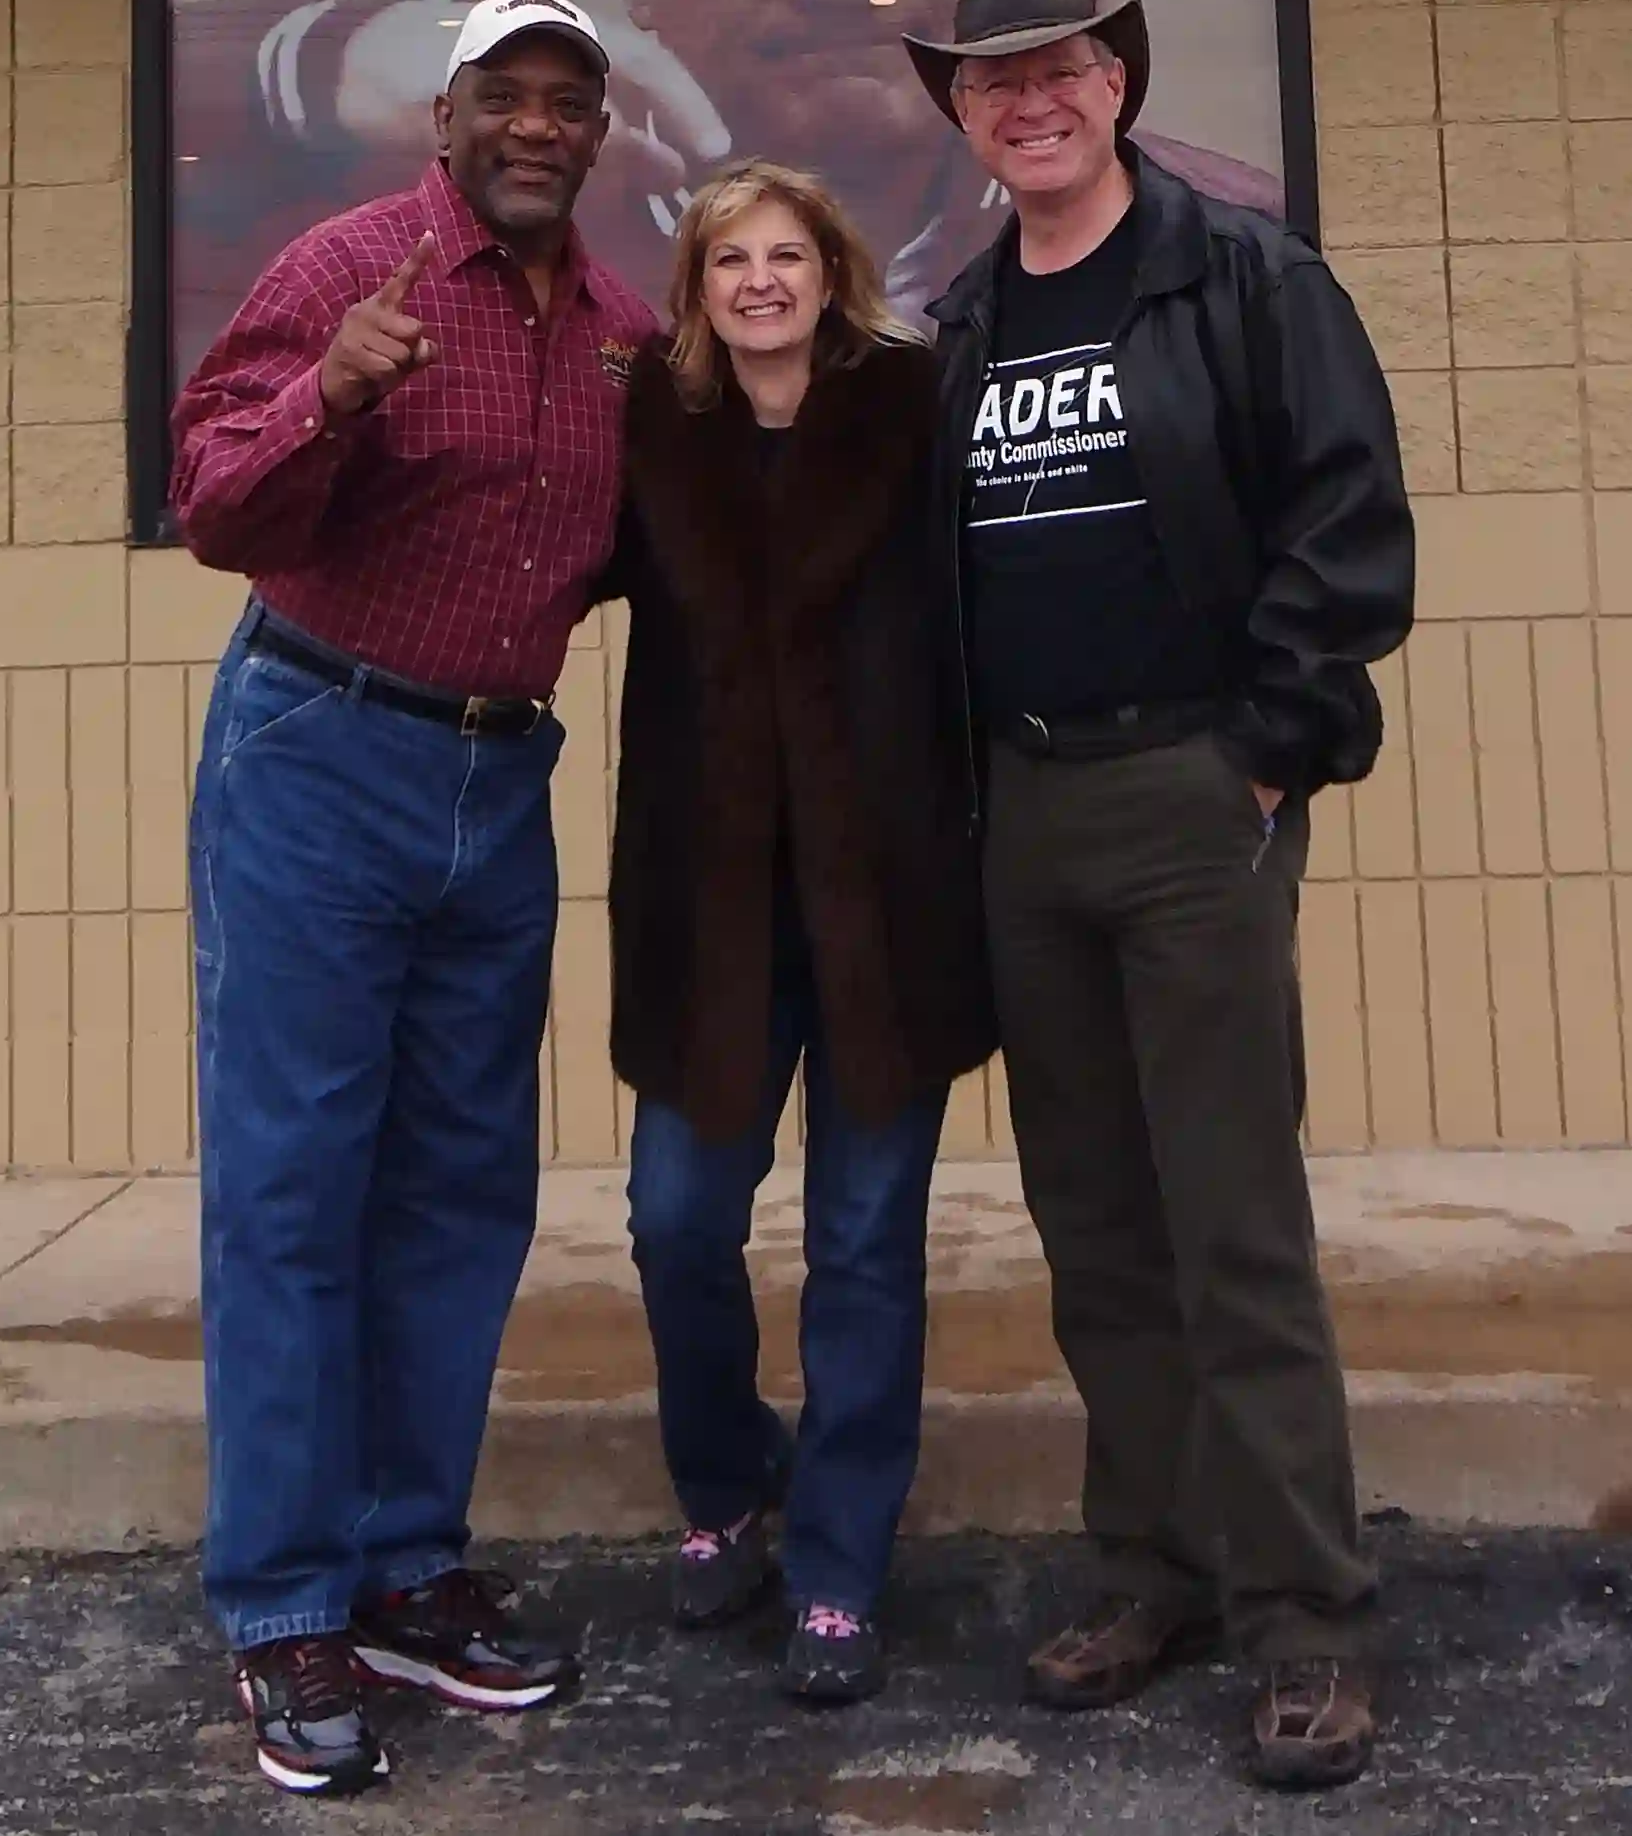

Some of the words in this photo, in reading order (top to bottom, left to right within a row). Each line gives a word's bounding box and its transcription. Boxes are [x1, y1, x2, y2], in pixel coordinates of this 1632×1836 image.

[1000, 430, 1127, 465] Commissioner
[989, 475, 1012, 486] choice
[1065, 464, 1088, 476] white
